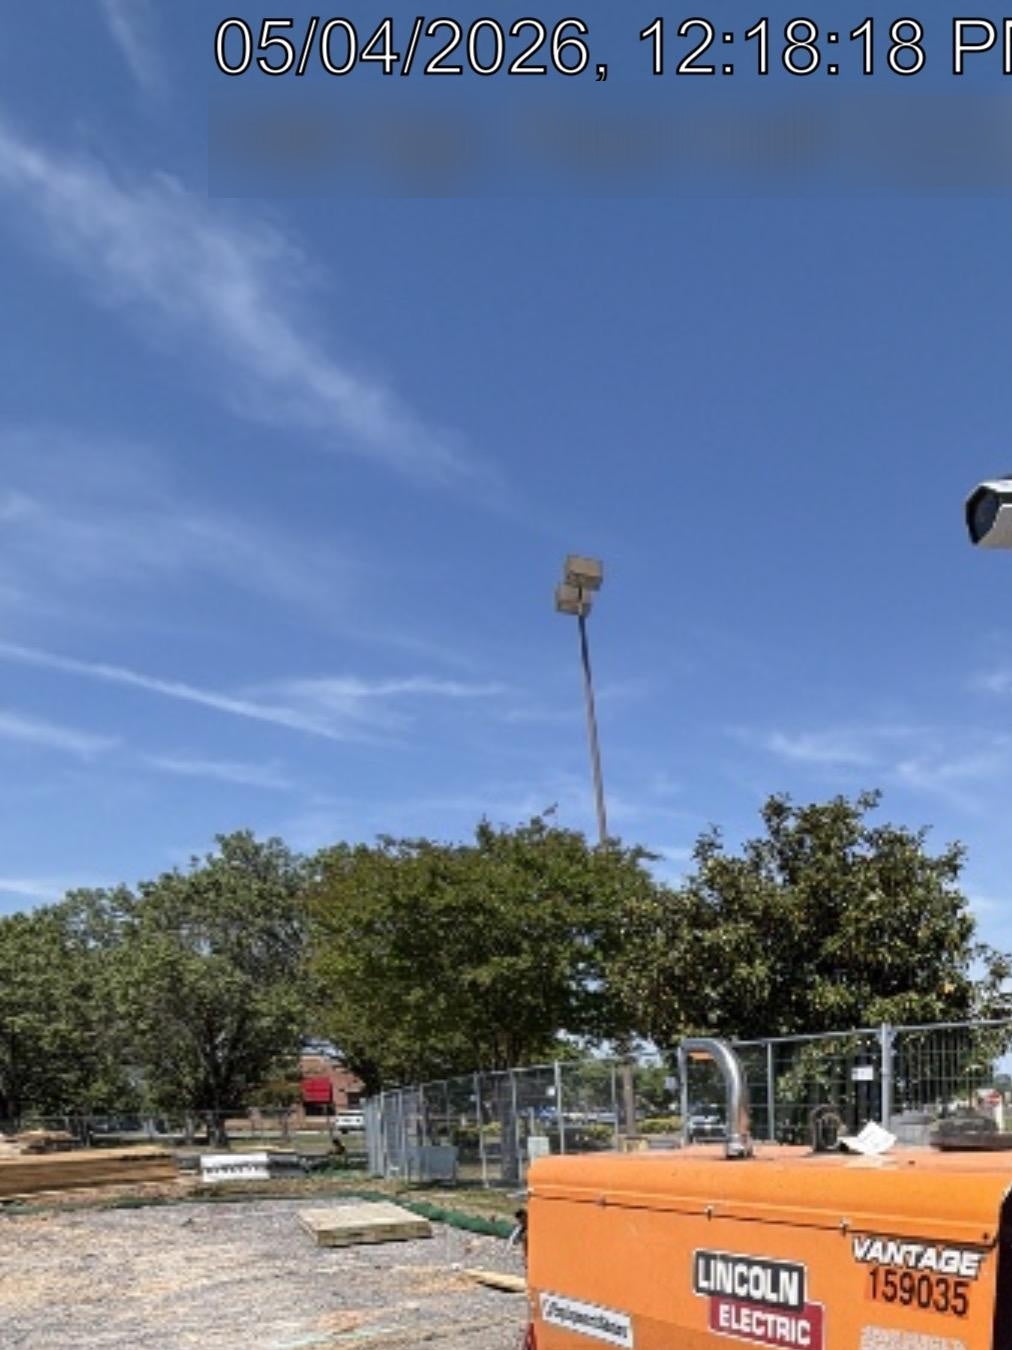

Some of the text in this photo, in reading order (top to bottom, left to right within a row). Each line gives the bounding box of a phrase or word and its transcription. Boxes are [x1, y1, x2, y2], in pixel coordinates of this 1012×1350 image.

[697, 1255, 800, 1307] LINCOLN
[853, 1237, 984, 1278] VANTAGE
[869, 1266, 970, 1317] 159035
[718, 1303, 812, 1346] ELECTRIC
